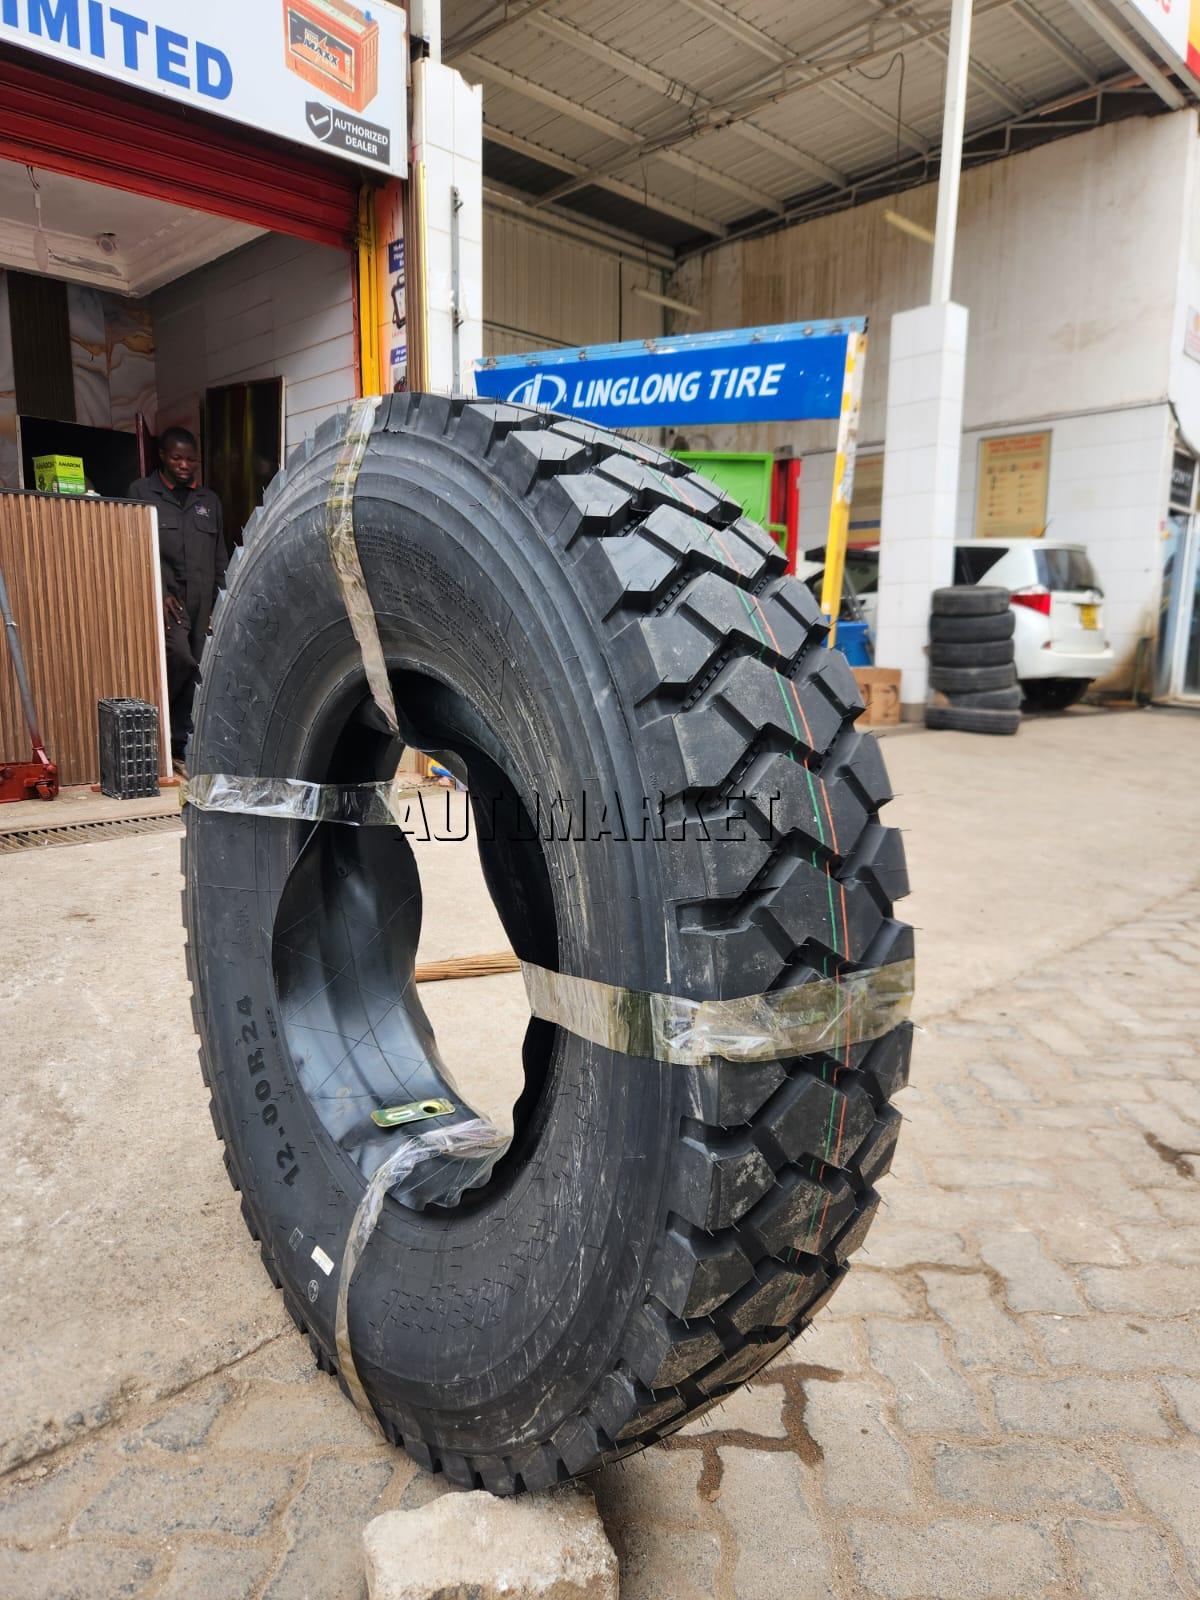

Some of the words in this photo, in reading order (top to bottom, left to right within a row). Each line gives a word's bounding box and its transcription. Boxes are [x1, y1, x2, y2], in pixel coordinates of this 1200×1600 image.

[304, 39, 338, 65] MAXX
[334, 118, 389, 145] AUTHORIZED
[345, 136, 378, 155] DEALER
[572, 371, 702, 409] LINGLONG
[708, 363, 786, 400] TIRE
